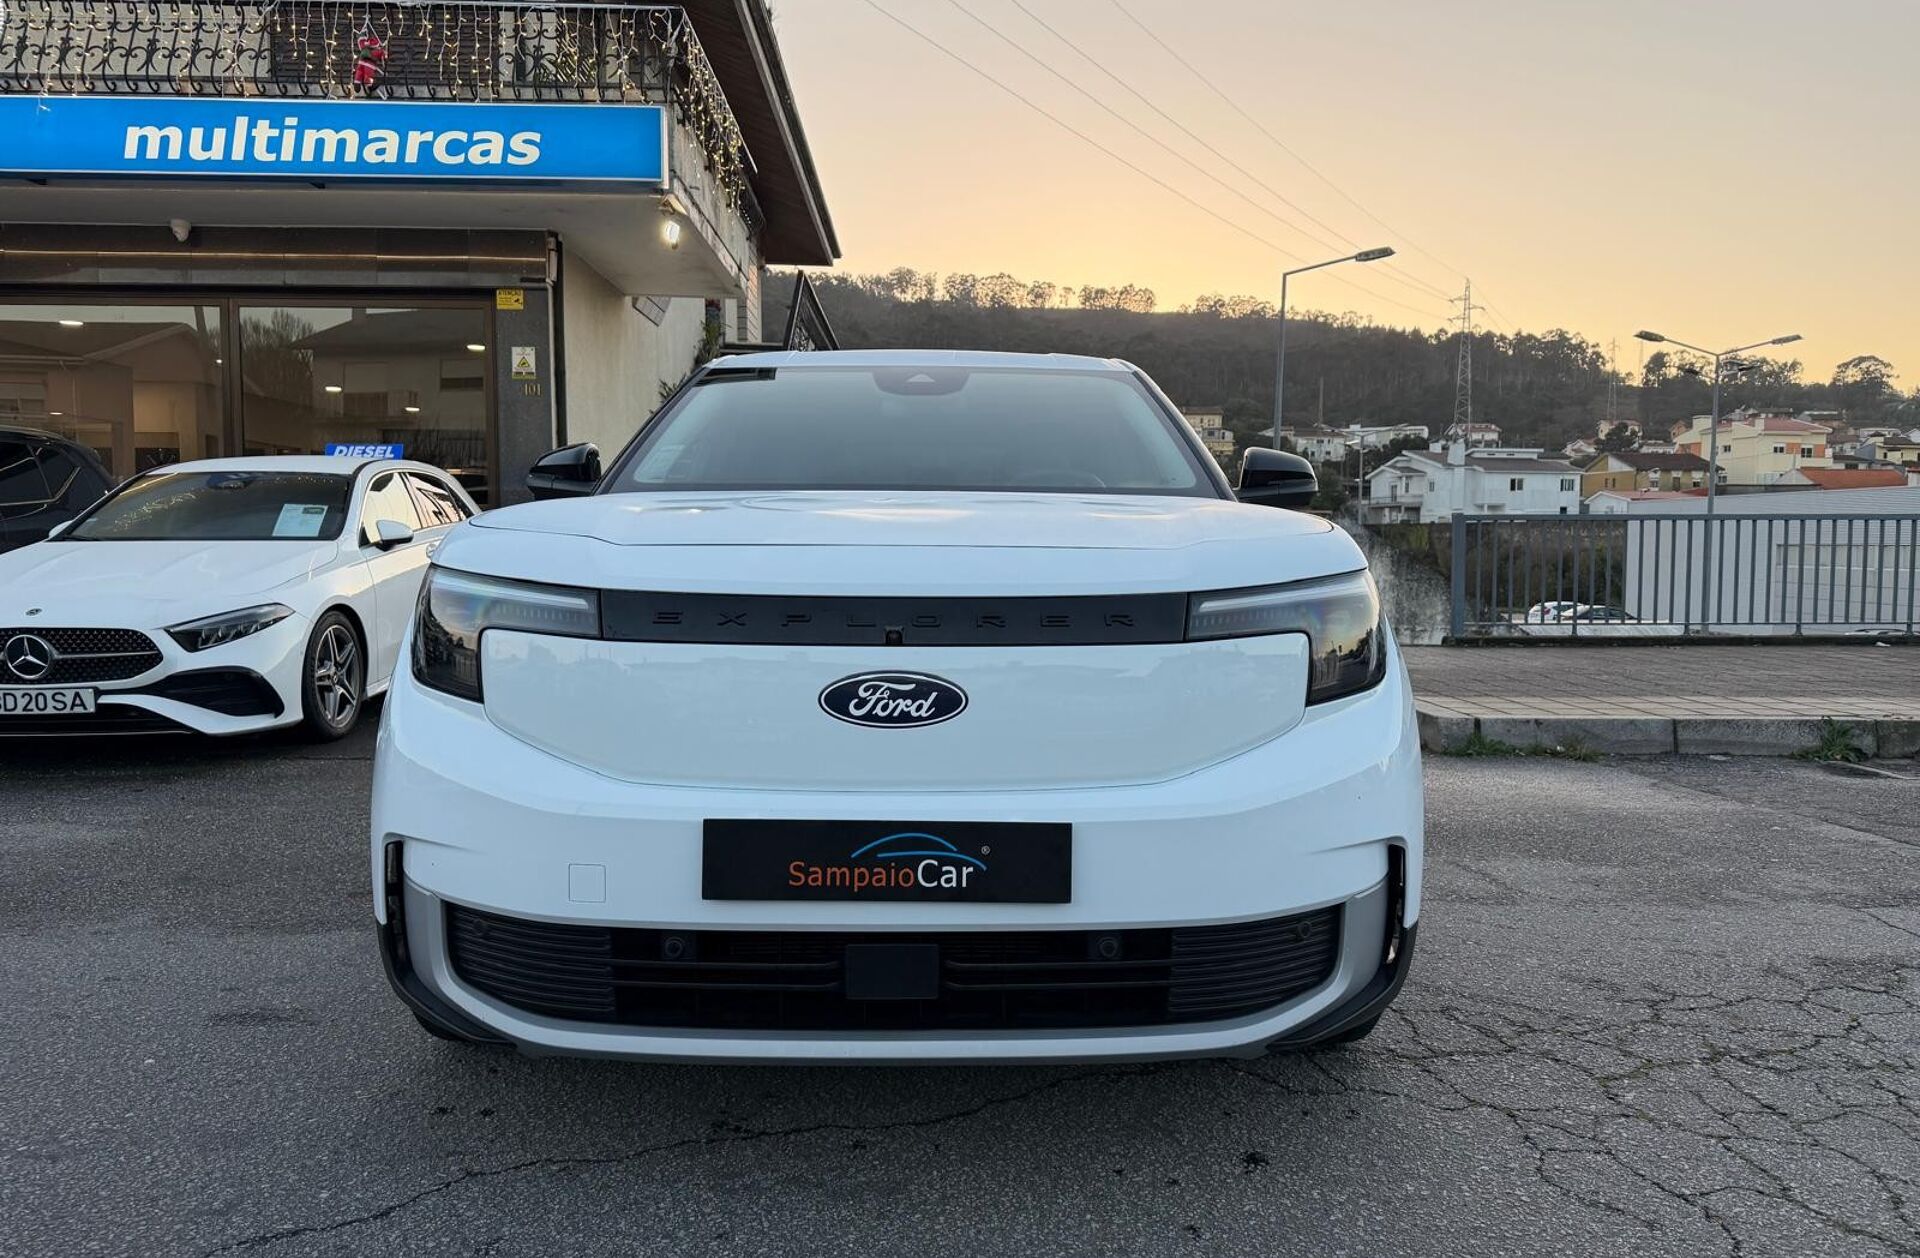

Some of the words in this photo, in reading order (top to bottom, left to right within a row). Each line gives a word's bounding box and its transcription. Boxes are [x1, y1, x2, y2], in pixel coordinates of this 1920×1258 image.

[124, 116, 541, 165] multimarcas
[333, 446, 394, 458] DIESEL
[652, 609, 1135, 629] EXPLORER
[848, 680, 936, 719] Ford
[789, 859, 973, 892] SampaioCar
